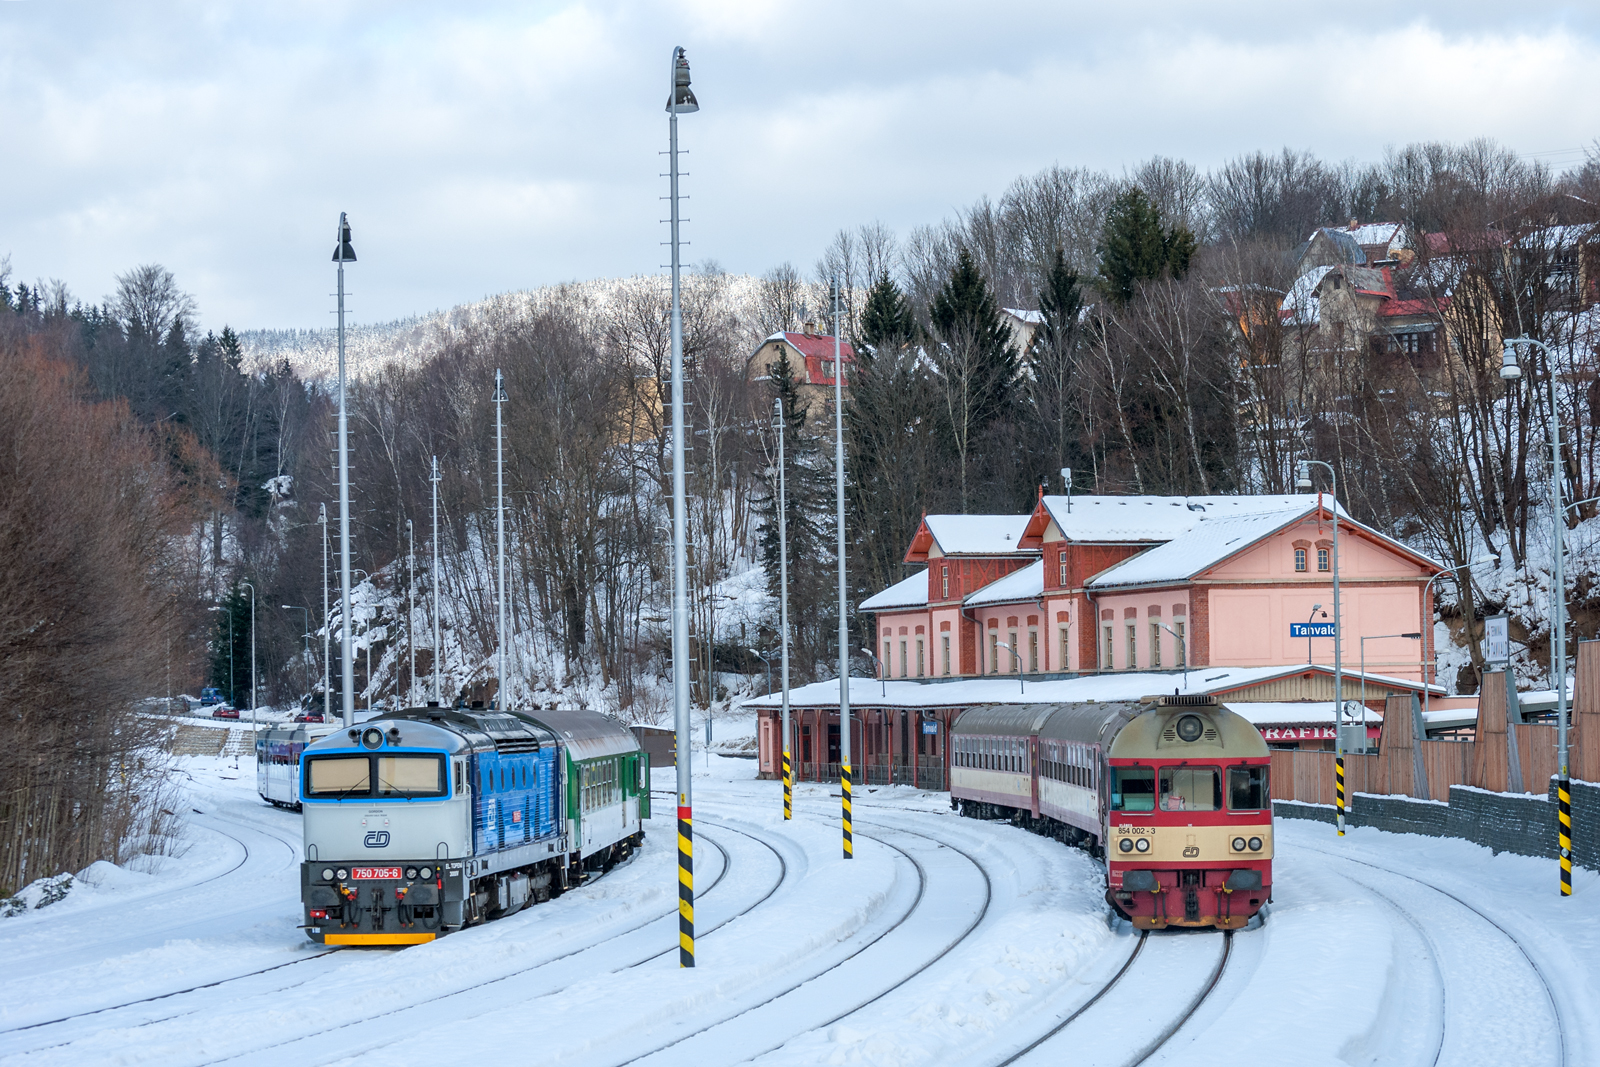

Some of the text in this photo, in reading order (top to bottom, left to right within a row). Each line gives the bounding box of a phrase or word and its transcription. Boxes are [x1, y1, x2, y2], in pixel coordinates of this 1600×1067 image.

[1260, 727, 1337, 739] RAFIK
[356, 868, 398, 878] 750 705-6
